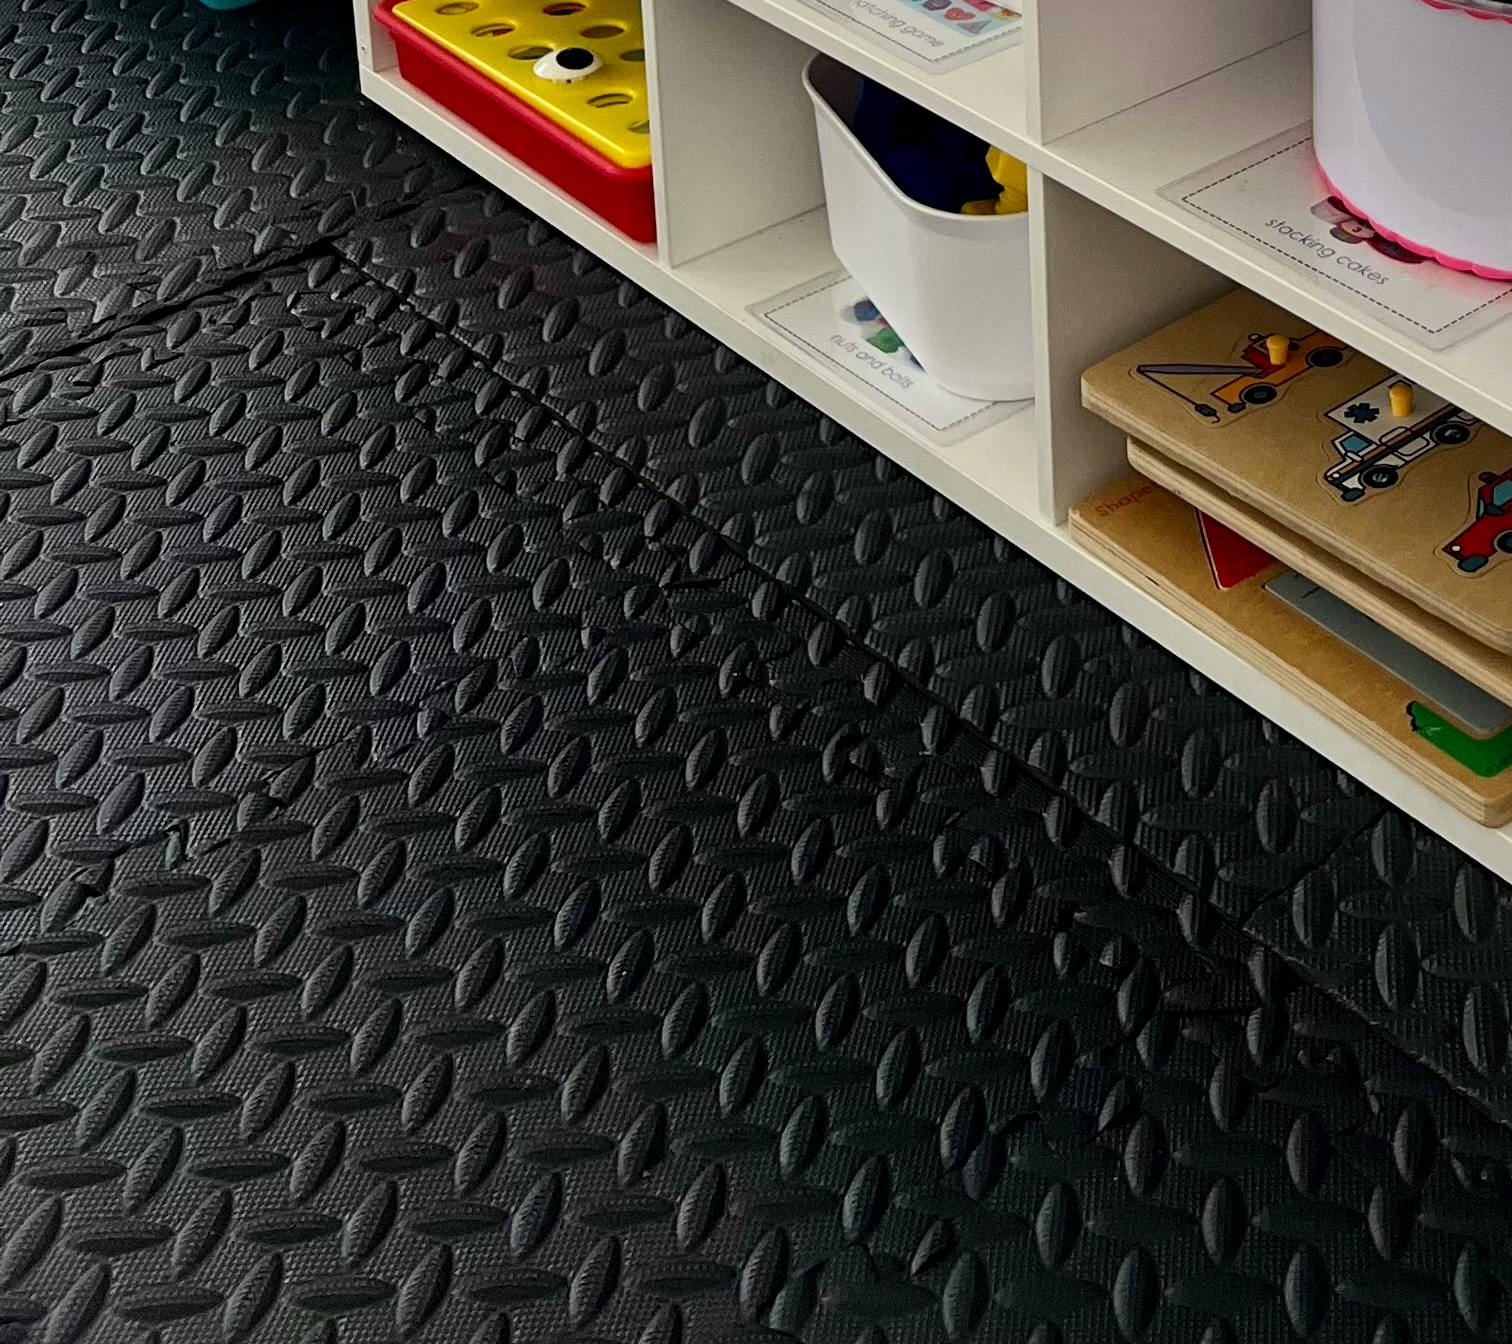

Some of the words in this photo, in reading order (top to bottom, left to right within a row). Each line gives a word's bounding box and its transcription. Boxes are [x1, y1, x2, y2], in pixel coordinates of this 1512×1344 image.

[901, 25, 944, 47] game
[1265, 218, 1336, 258] stacking
[1336, 256, 1389, 285] cakes
[830, 334, 858, 353] nuts
[855, 351, 888, 370] and
